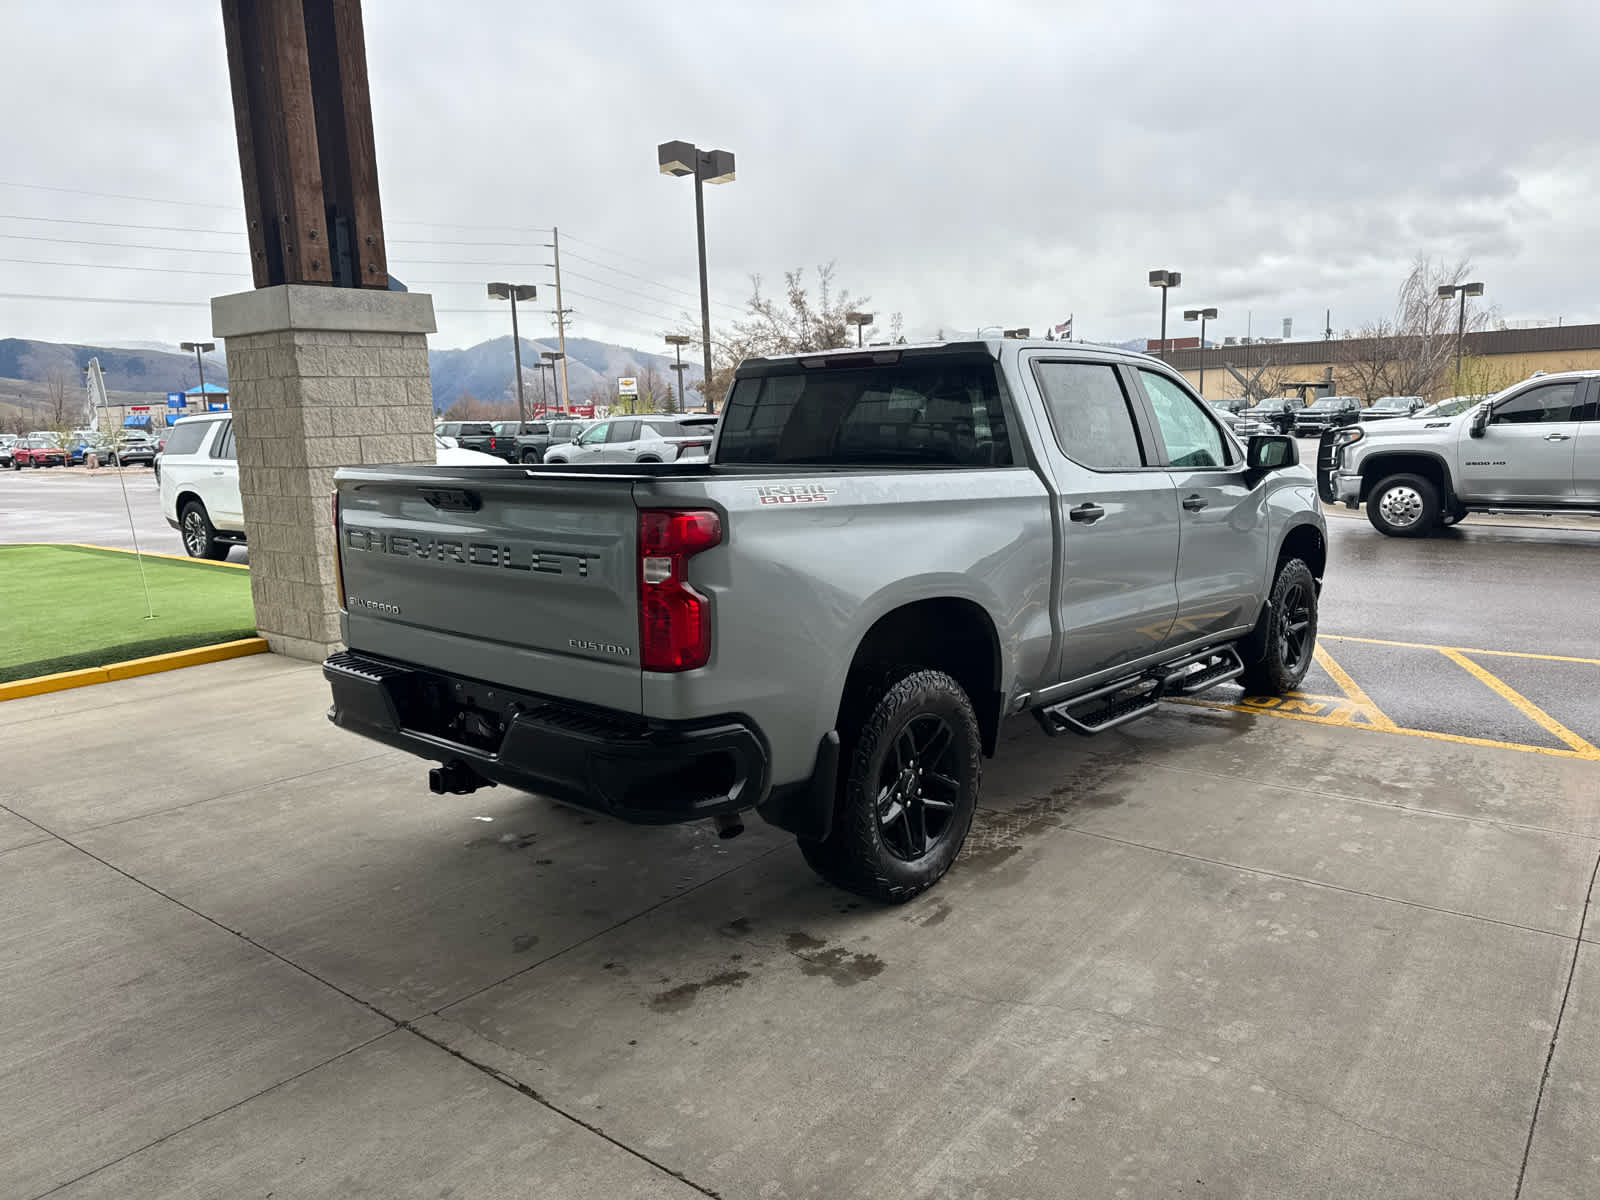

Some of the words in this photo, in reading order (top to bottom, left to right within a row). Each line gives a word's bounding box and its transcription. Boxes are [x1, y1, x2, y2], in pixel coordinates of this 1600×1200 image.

[745, 485, 837, 497] TRAIL
[760, 494, 829, 505] BOSS
[346, 529, 601, 577] CHEVROLET
[349, 596, 401, 615] SILVERADO
[568, 639, 631, 657] CUSTOM
